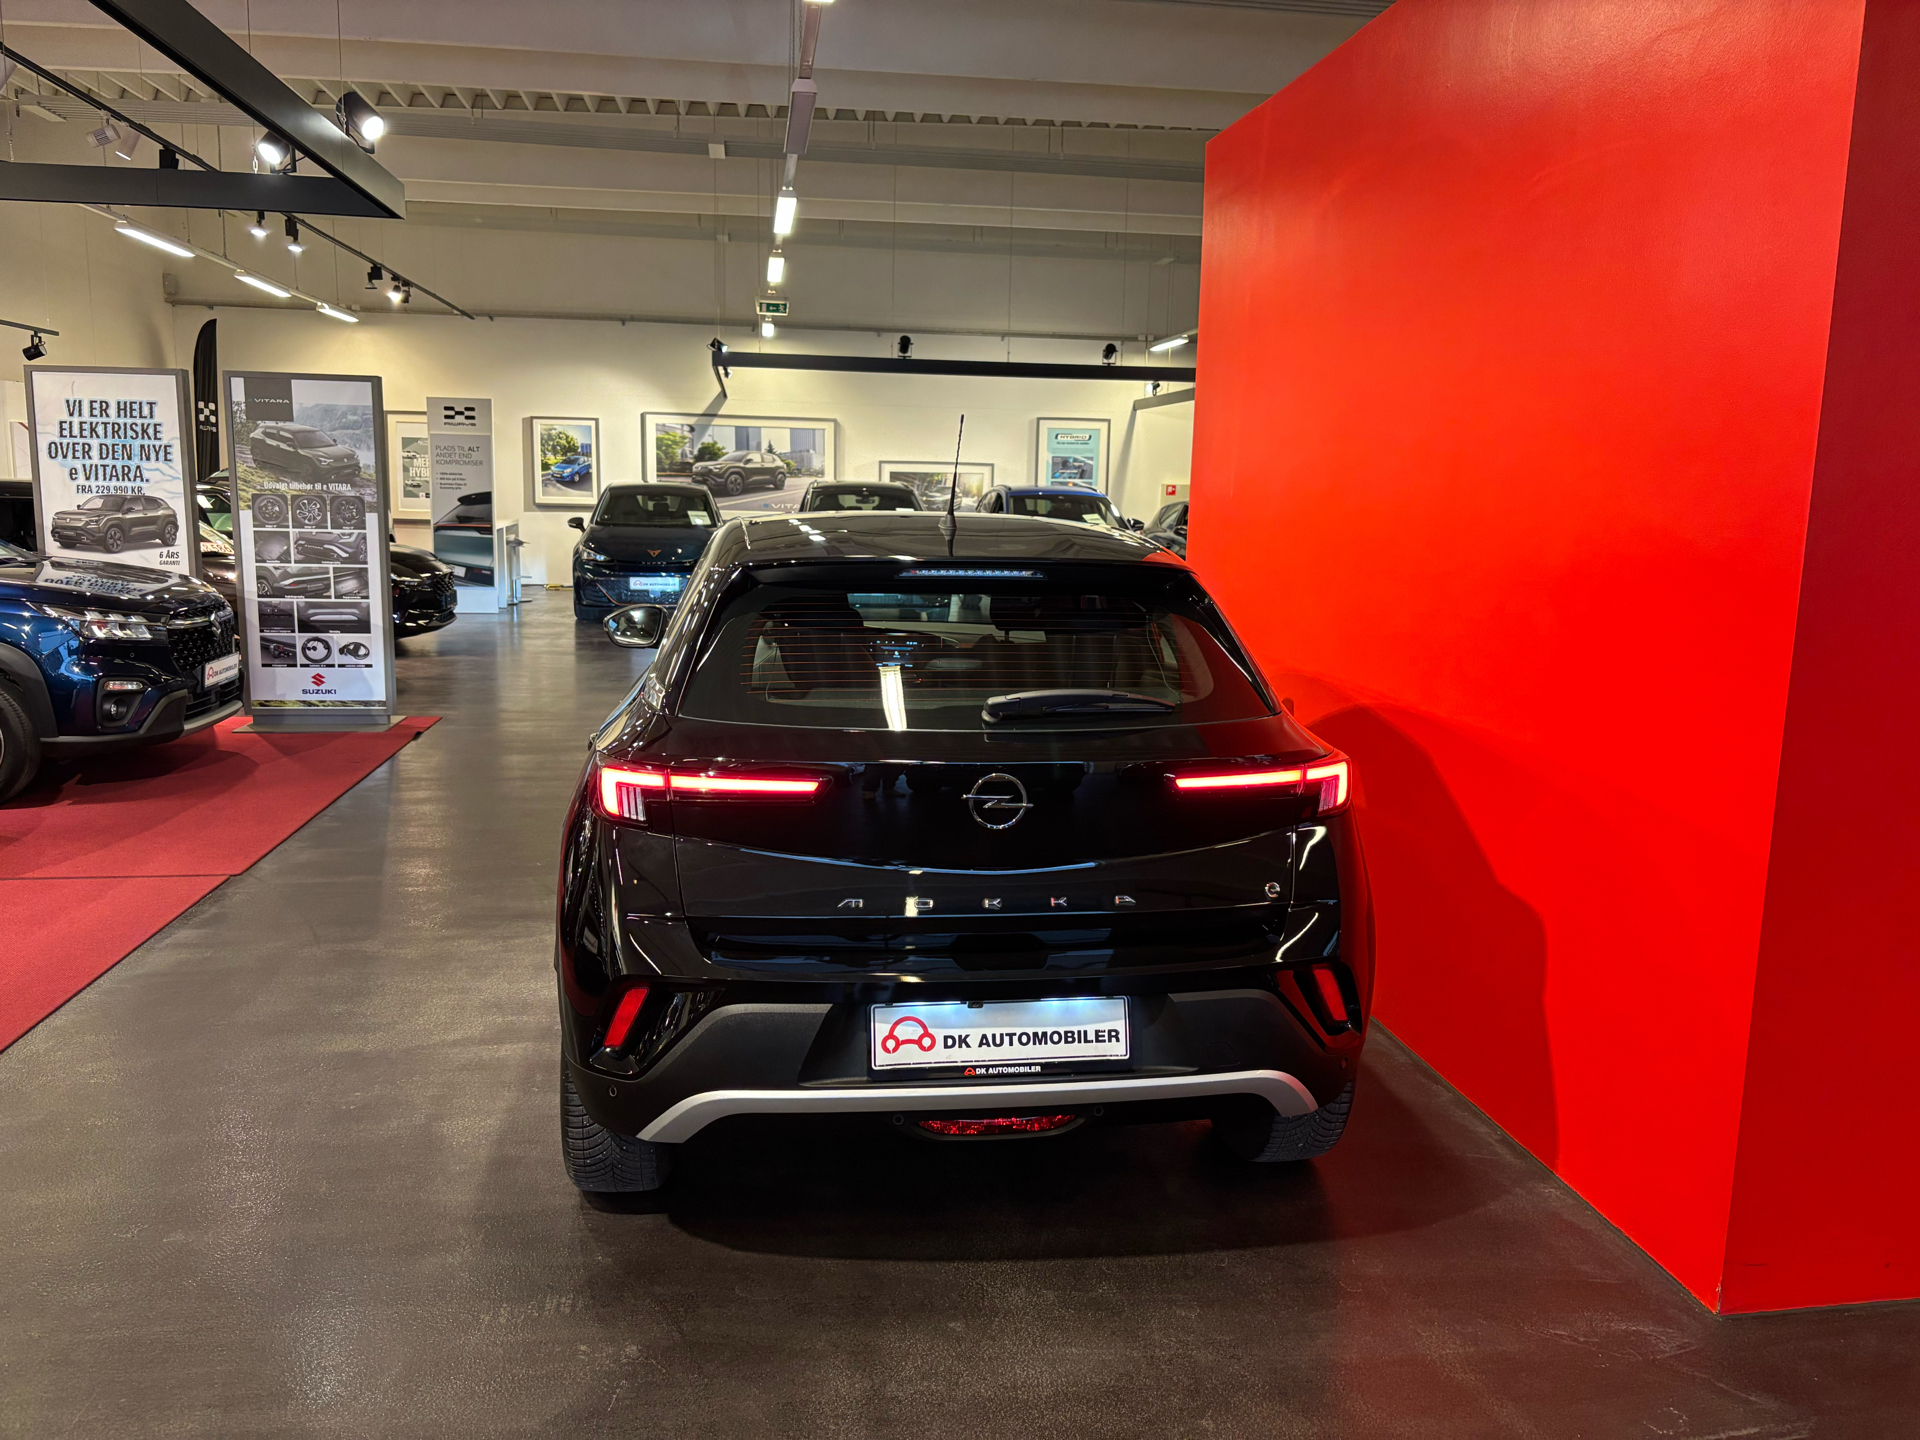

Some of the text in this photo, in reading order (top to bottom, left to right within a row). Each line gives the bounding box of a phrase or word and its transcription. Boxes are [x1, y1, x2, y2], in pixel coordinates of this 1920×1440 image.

[66, 400, 156, 419] VI ER HELT
[59, 421, 162, 440] ELEKTRISKE
[48, 442, 172, 462] OVER DEN NYE
[69, 464, 149, 483] e VITARA.
[76, 485, 93, 494] FRA
[96, 485, 128, 494] 229.990
[263, 481, 288, 490] Udvalgt
[289, 482, 313, 491] tilbehør
[328, 483, 352, 491] VITARA
[165, 550, 180, 559] ÅRS
[943, 1028, 1120, 1049] DK AUTOMOBILER
[976, 1065, 1042, 1075] DK AUTOMOBILER
